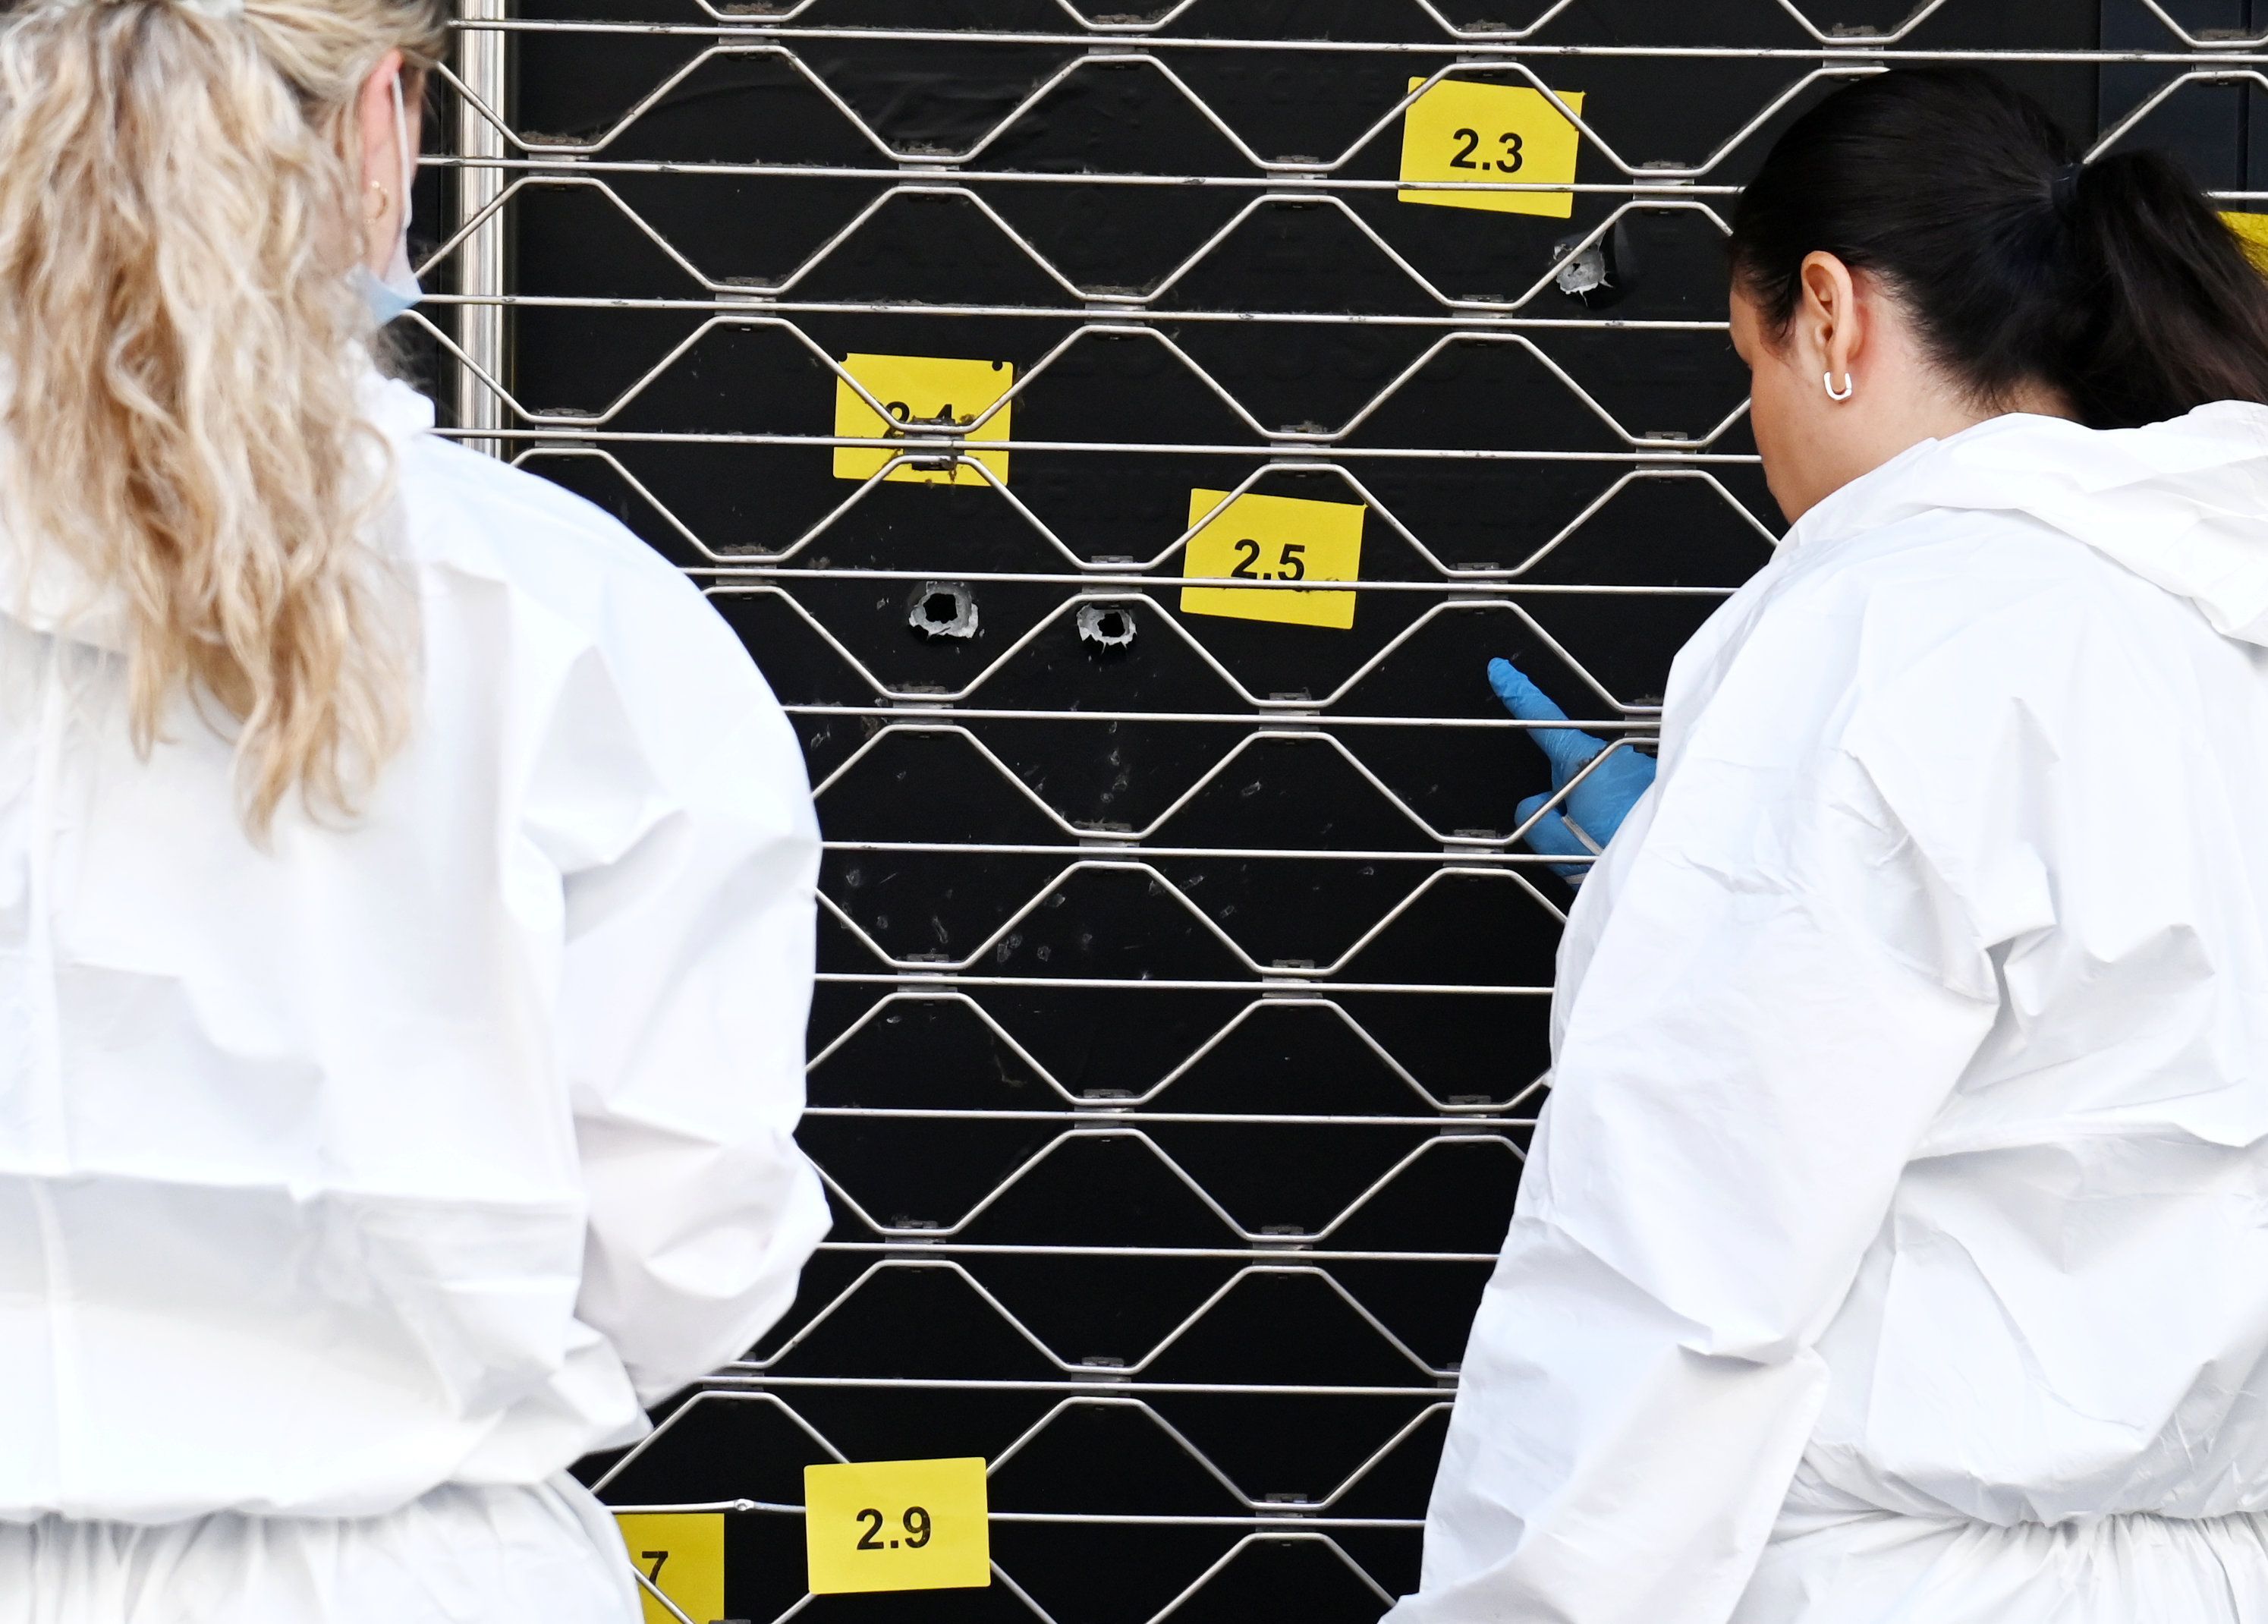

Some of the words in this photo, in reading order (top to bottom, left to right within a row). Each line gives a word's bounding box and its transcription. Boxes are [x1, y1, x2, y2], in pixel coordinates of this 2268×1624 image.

[1450, 127, 1523, 173] 2.3
[1231, 539, 1305, 581] 2.5
[856, 1506, 931, 1550] 2.9
